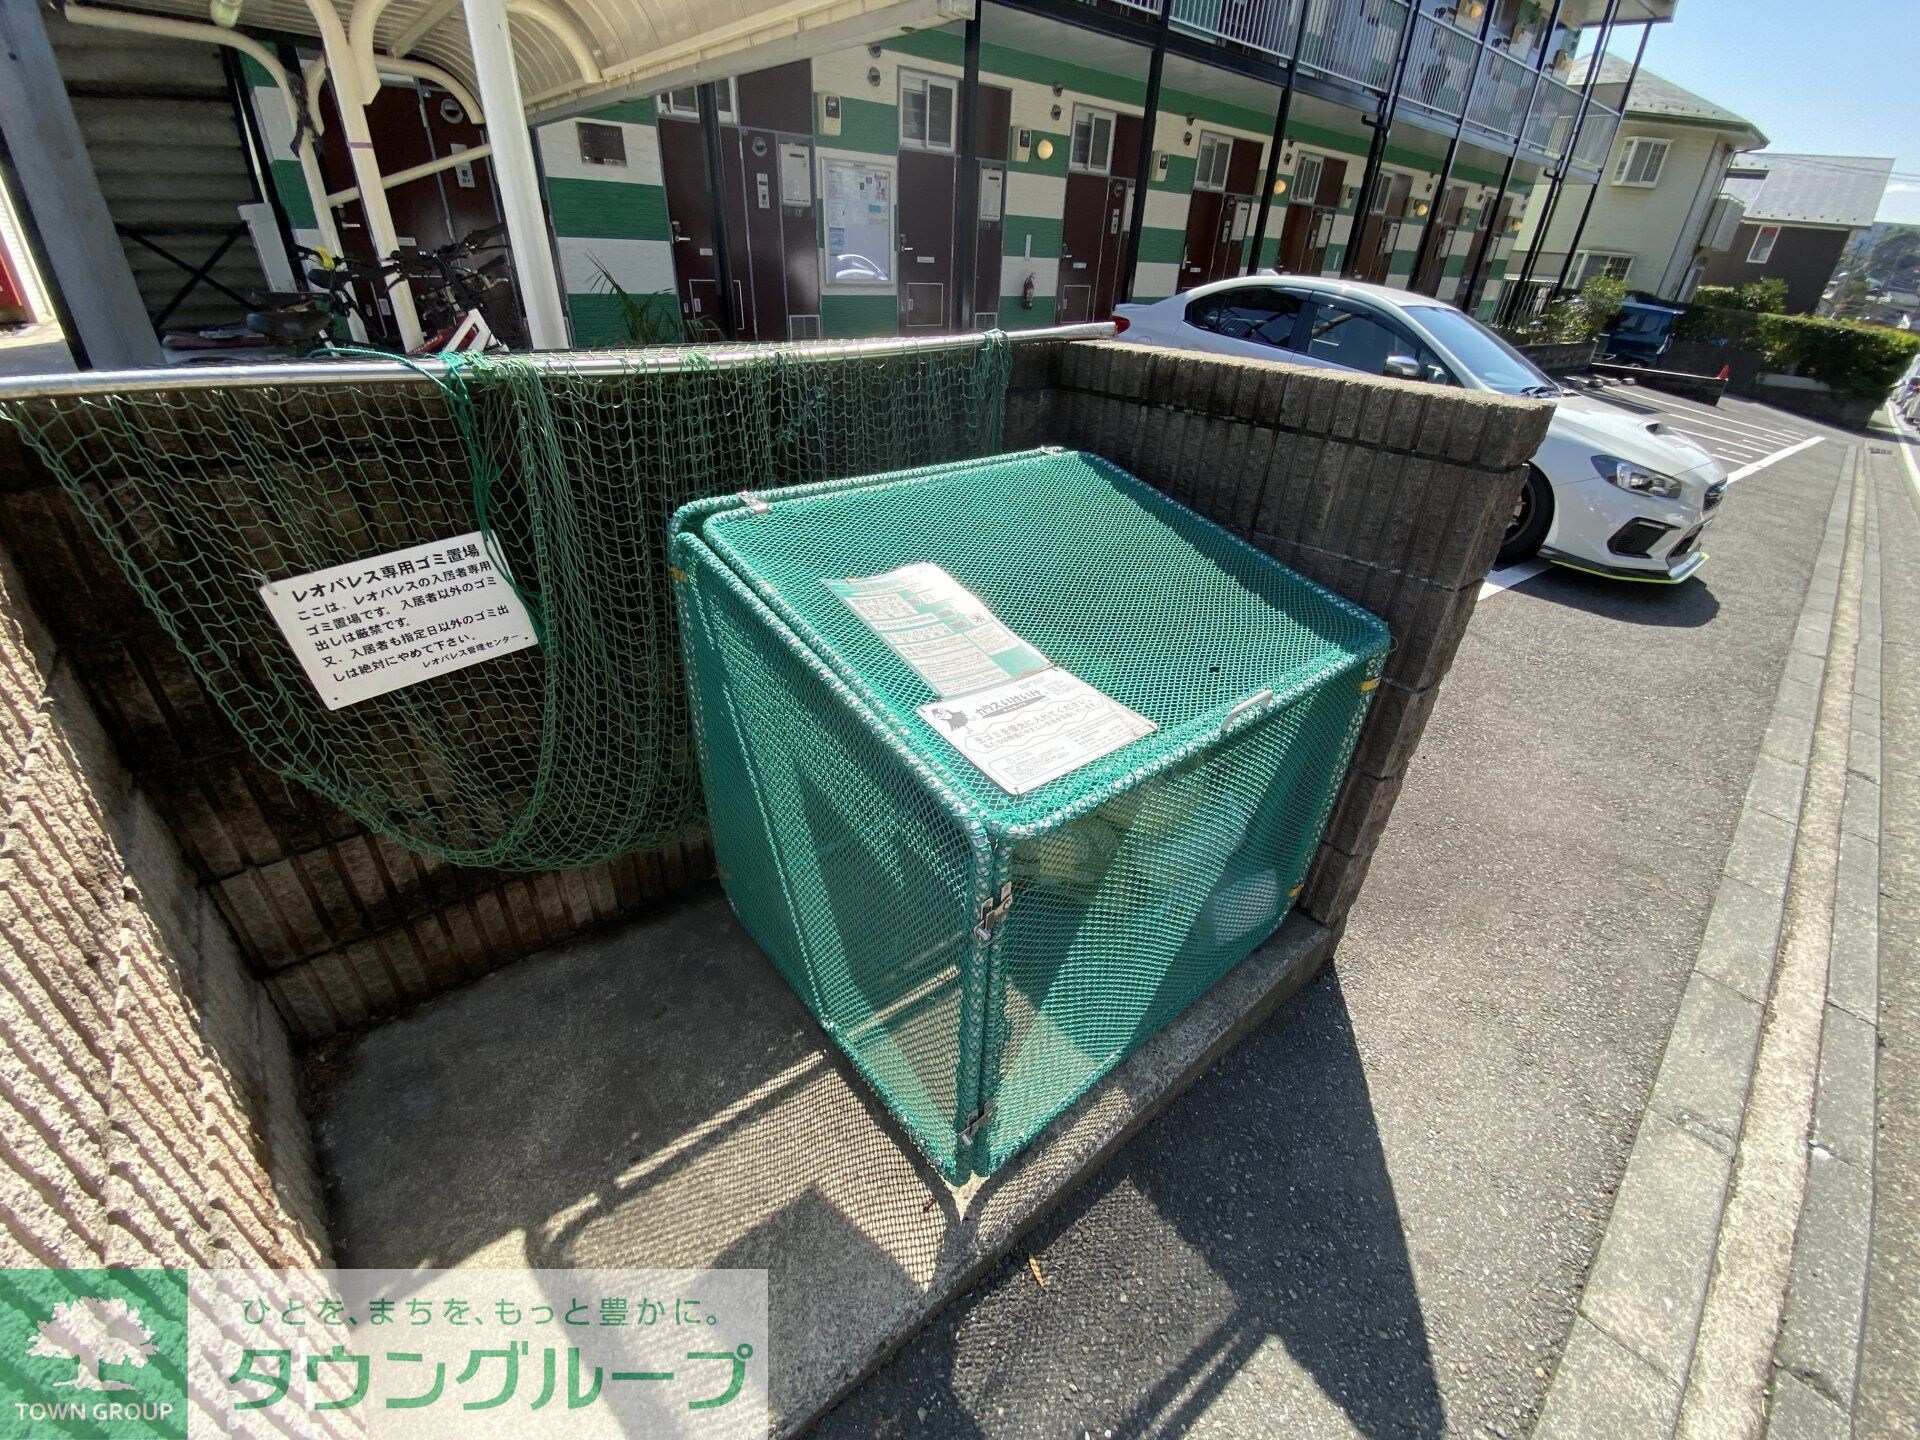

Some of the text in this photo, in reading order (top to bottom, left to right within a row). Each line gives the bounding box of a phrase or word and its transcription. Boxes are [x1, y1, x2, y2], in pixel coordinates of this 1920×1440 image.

[291, 543, 480, 603] レオパレス専用ゴミ置場
[297, 560, 492, 621] ここは、レオパレスの入居者専用
[314, 616, 411, 652] 出しは厳禁です。
[321, 604, 510, 668] 又、入居者も指定日以外のゴミ出
[333, 633, 476, 683] しは絶対にやめて下さい。
[422, 634, 519, 668] レオパレス管理センター
